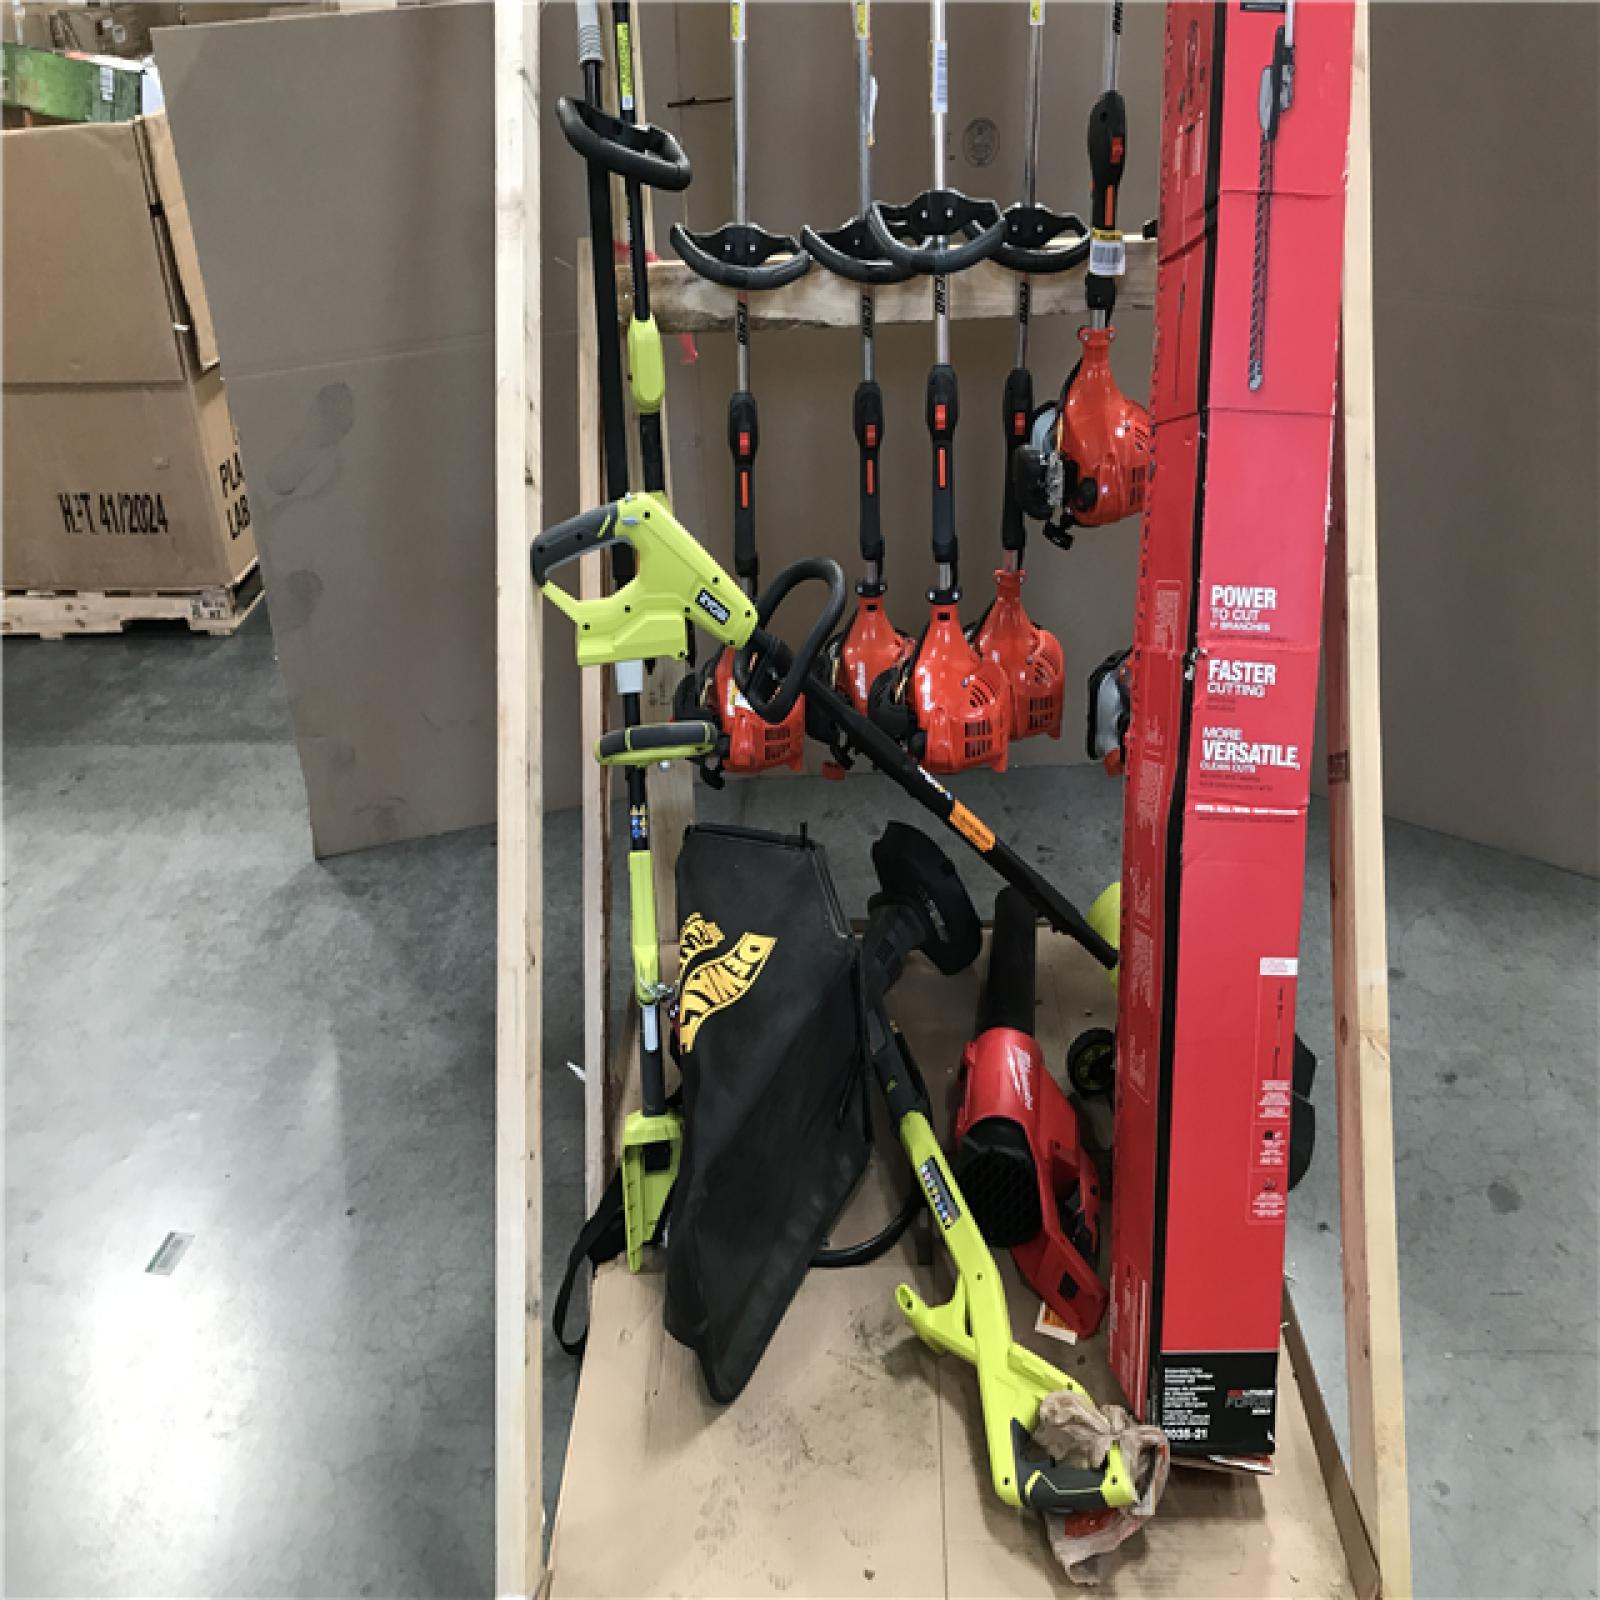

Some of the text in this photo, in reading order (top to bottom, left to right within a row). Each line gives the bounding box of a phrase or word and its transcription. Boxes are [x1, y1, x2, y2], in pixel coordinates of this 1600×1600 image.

[1210, 584, 1277, 609] POWER
[1232, 608, 1260, 622] CUT
[1208, 659, 1276, 686] FASTER
[1206, 682, 1266, 698] CUTTING
